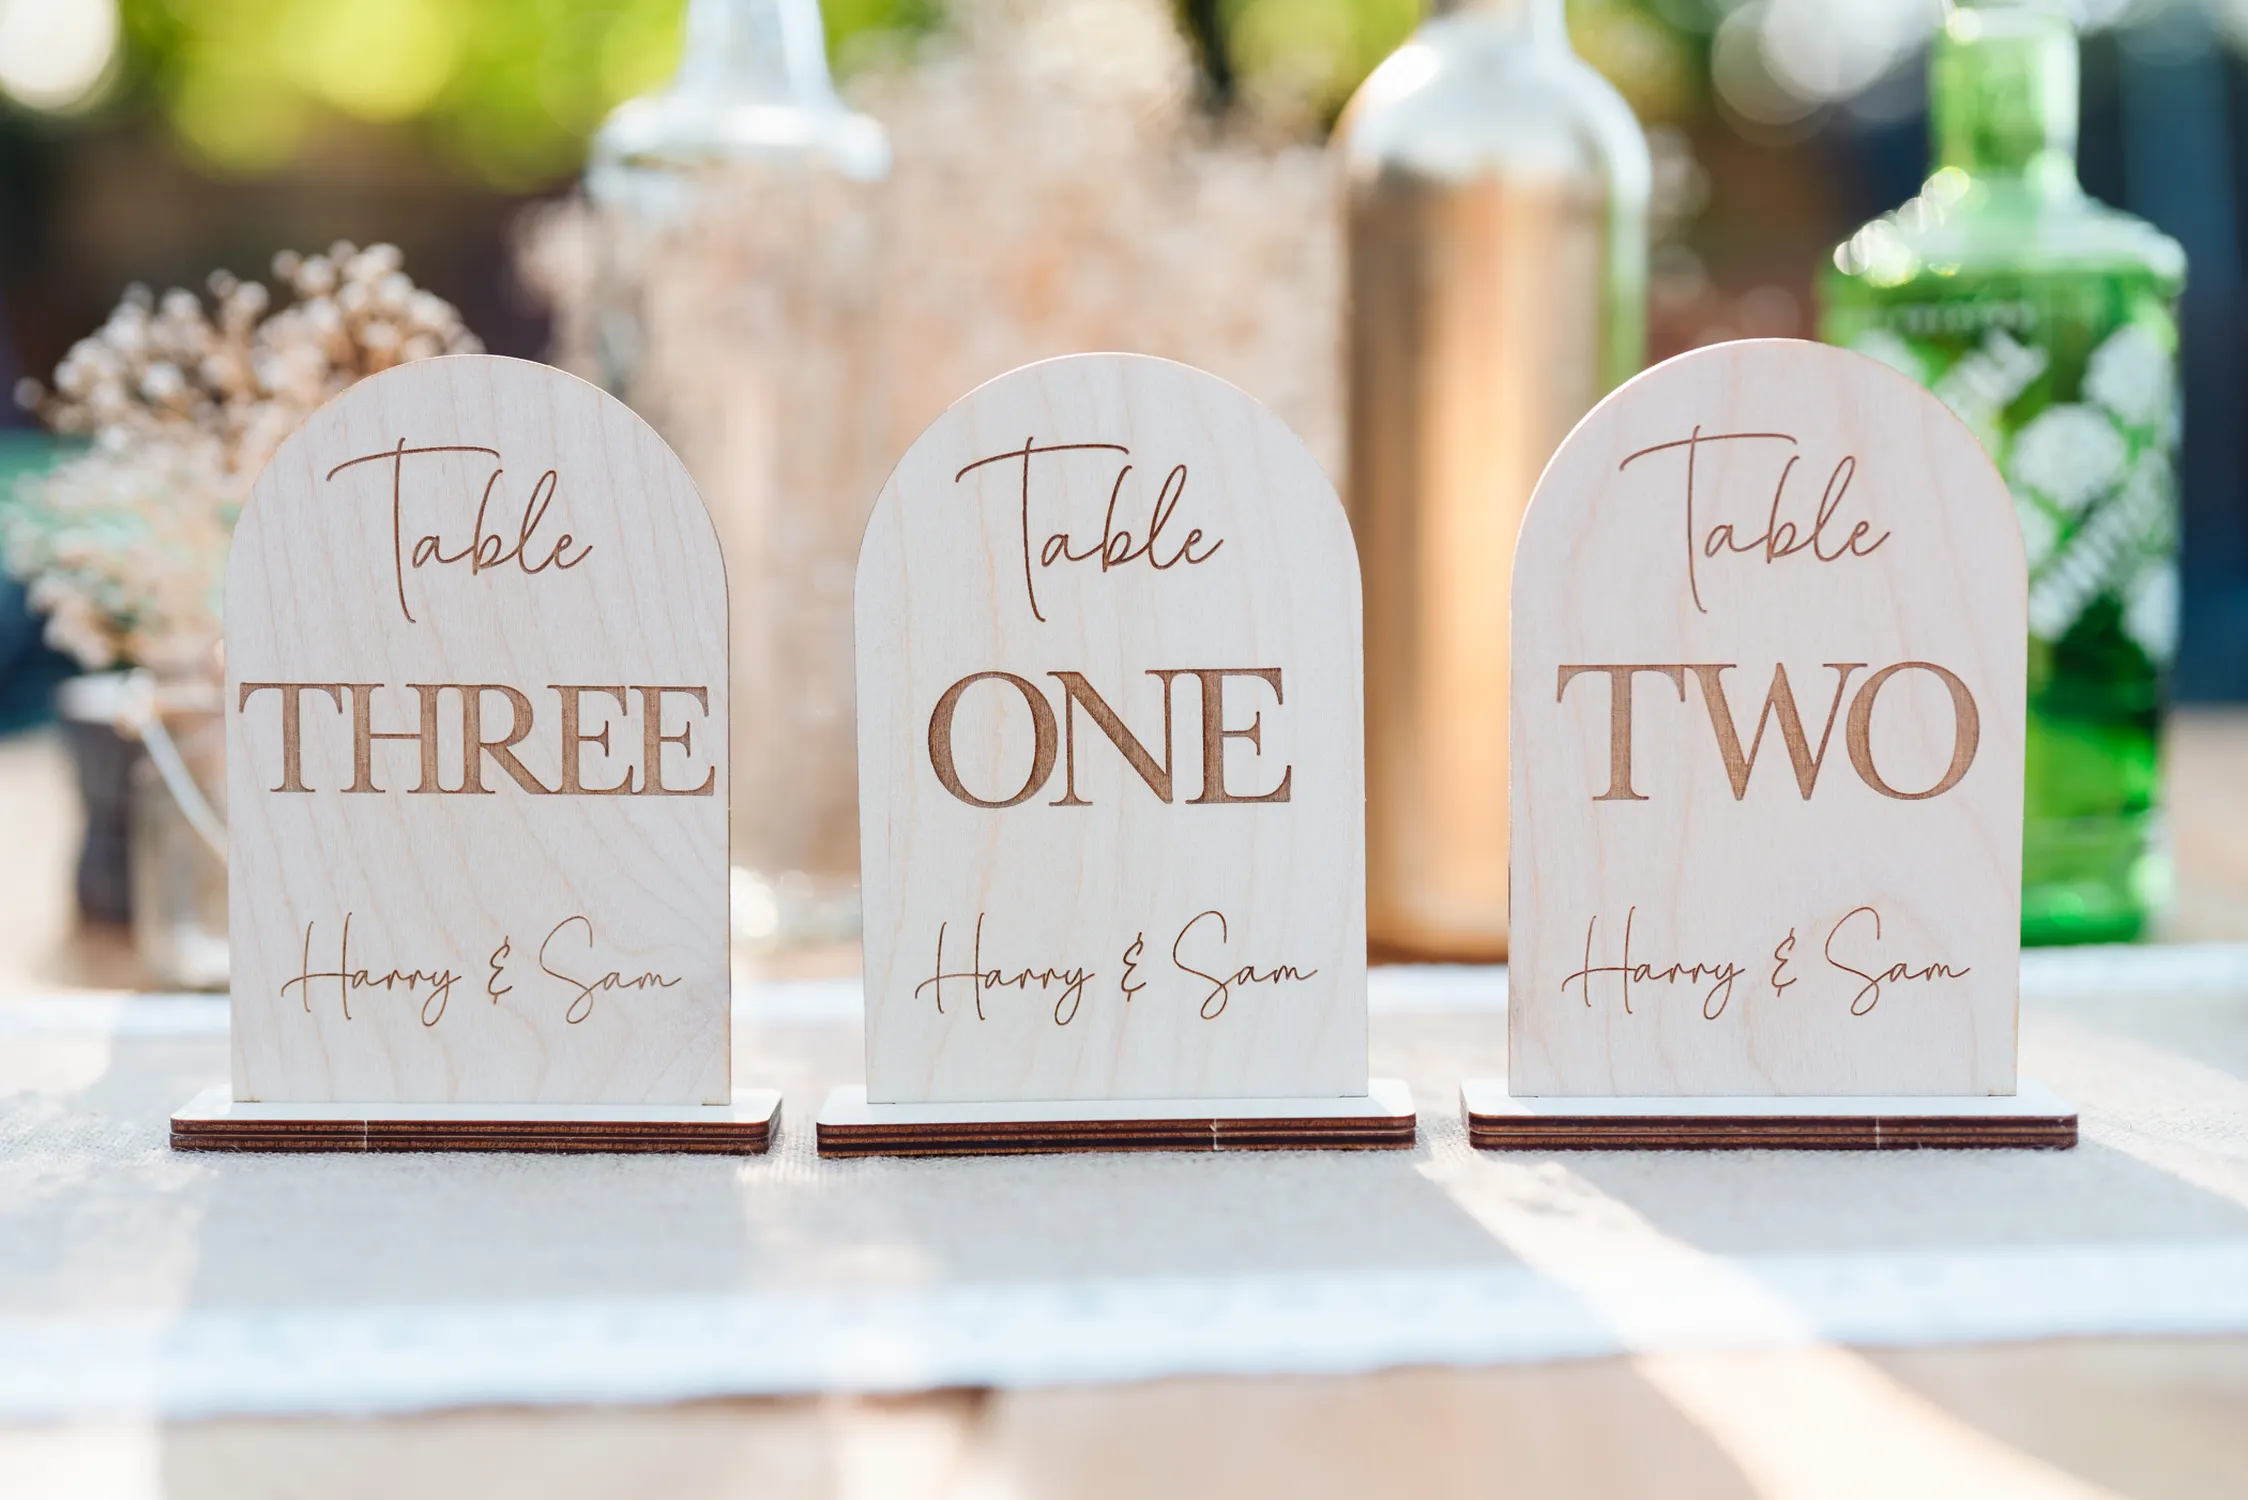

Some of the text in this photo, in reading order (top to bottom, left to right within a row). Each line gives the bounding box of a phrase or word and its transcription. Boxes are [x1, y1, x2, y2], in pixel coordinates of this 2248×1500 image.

[326, 437, 593, 623] Table
[955, 436, 1224, 623] Table
[1619, 425, 1891, 613] Table
[239, 682, 715, 796] THREE
[928, 667, 1292, 809] ONE
[1556, 661, 1980, 801] TWO
[281, 912, 682, 1027] Harry & Sam
[915, 911, 1318, 1026] Harry & Sam
[1561, 906, 1970, 1020] Harry & Sam
